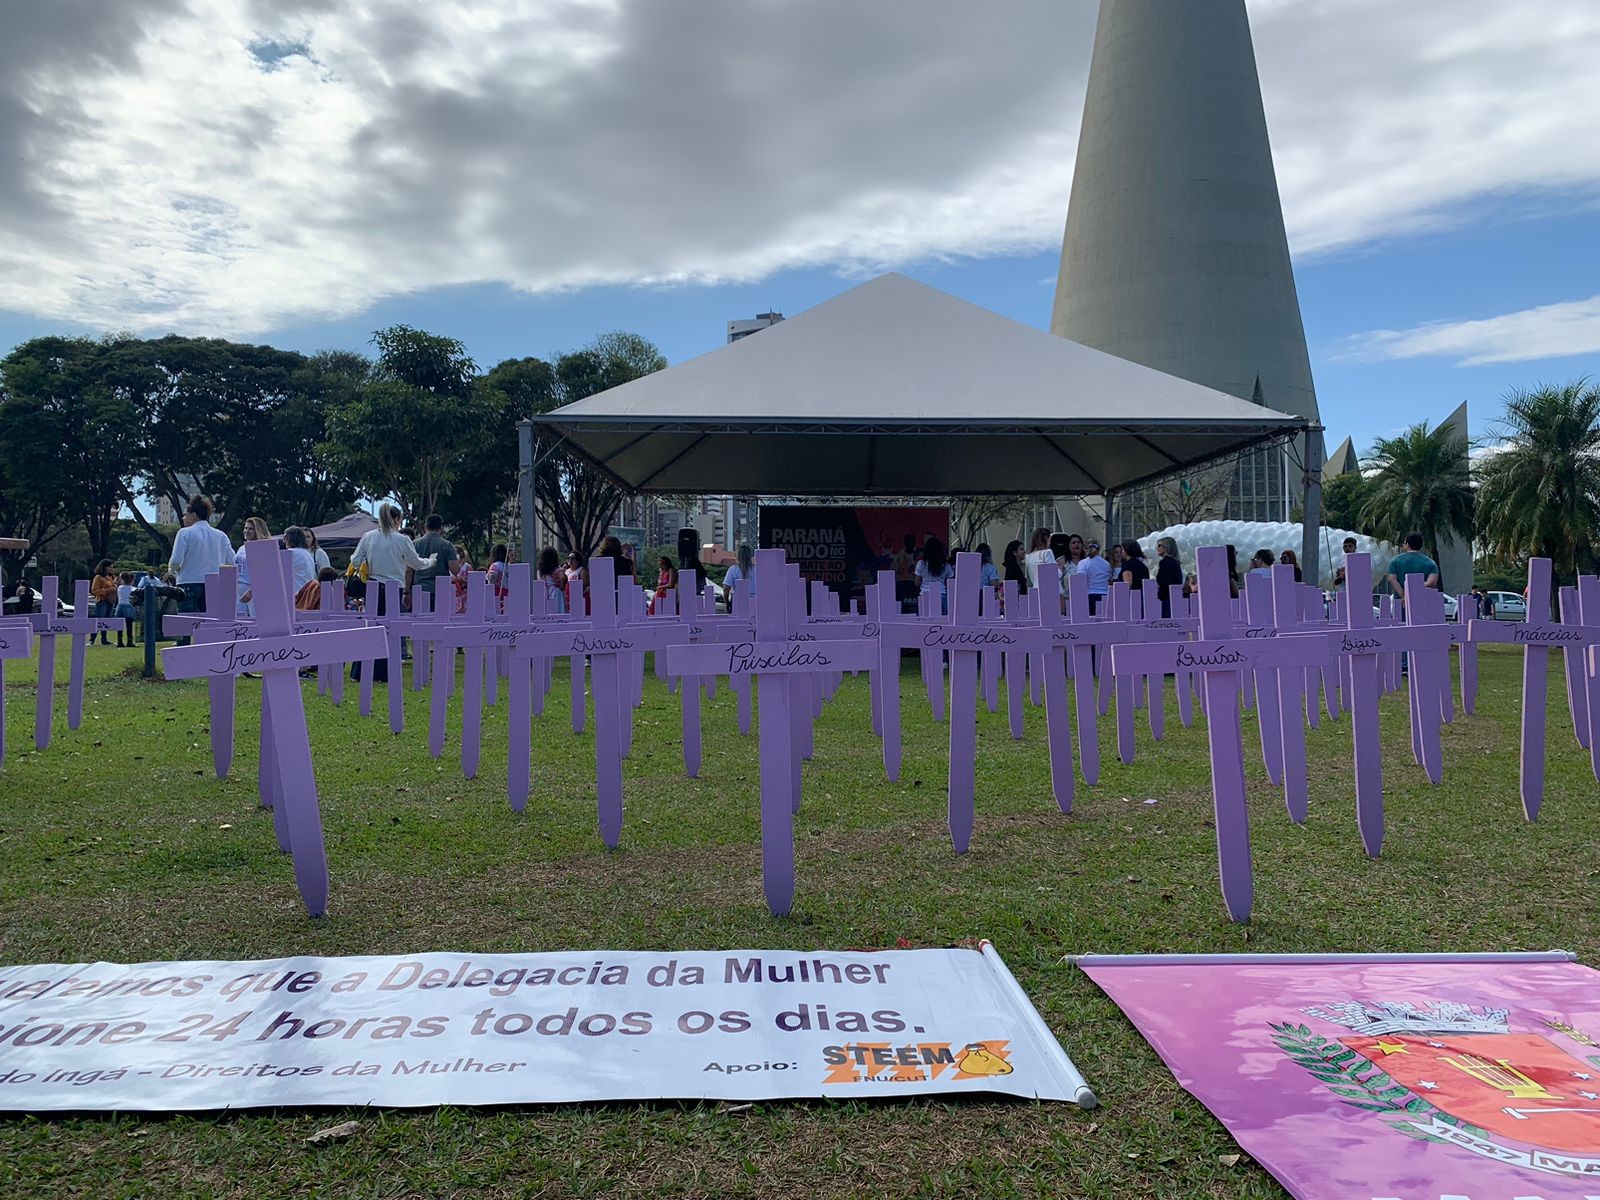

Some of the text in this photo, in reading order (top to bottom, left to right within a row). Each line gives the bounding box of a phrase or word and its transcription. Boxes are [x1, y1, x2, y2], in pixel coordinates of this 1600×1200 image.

[772, 525, 845, 543] PARANÁ
[830, 546, 846, 556] NO
[924, 625, 1017, 647] Eurides
[1503, 624, 1582, 641] Márcias
[209, 642, 311, 673] Irenes
[725, 643, 832, 673] Priscilas
[1176, 645, 1248, 666] Luísas
[0, 958, 891, 1002] ueremos que a Delegacia da Mulher
[0, 1003, 925, 1046] ione 24 horas todos os dias.
[822, 1045, 955, 1066] STEEM
[41, 1065, 133, 1086] Ingá
[160, 1063, 324, 1079] Direitos
[331, 1060, 382, 1076] da
[391, 1058, 527, 1075] Mulher
[703, 1061, 797, 1074] Apoio:
[1435, 1126, 1522, 1160] 1947
